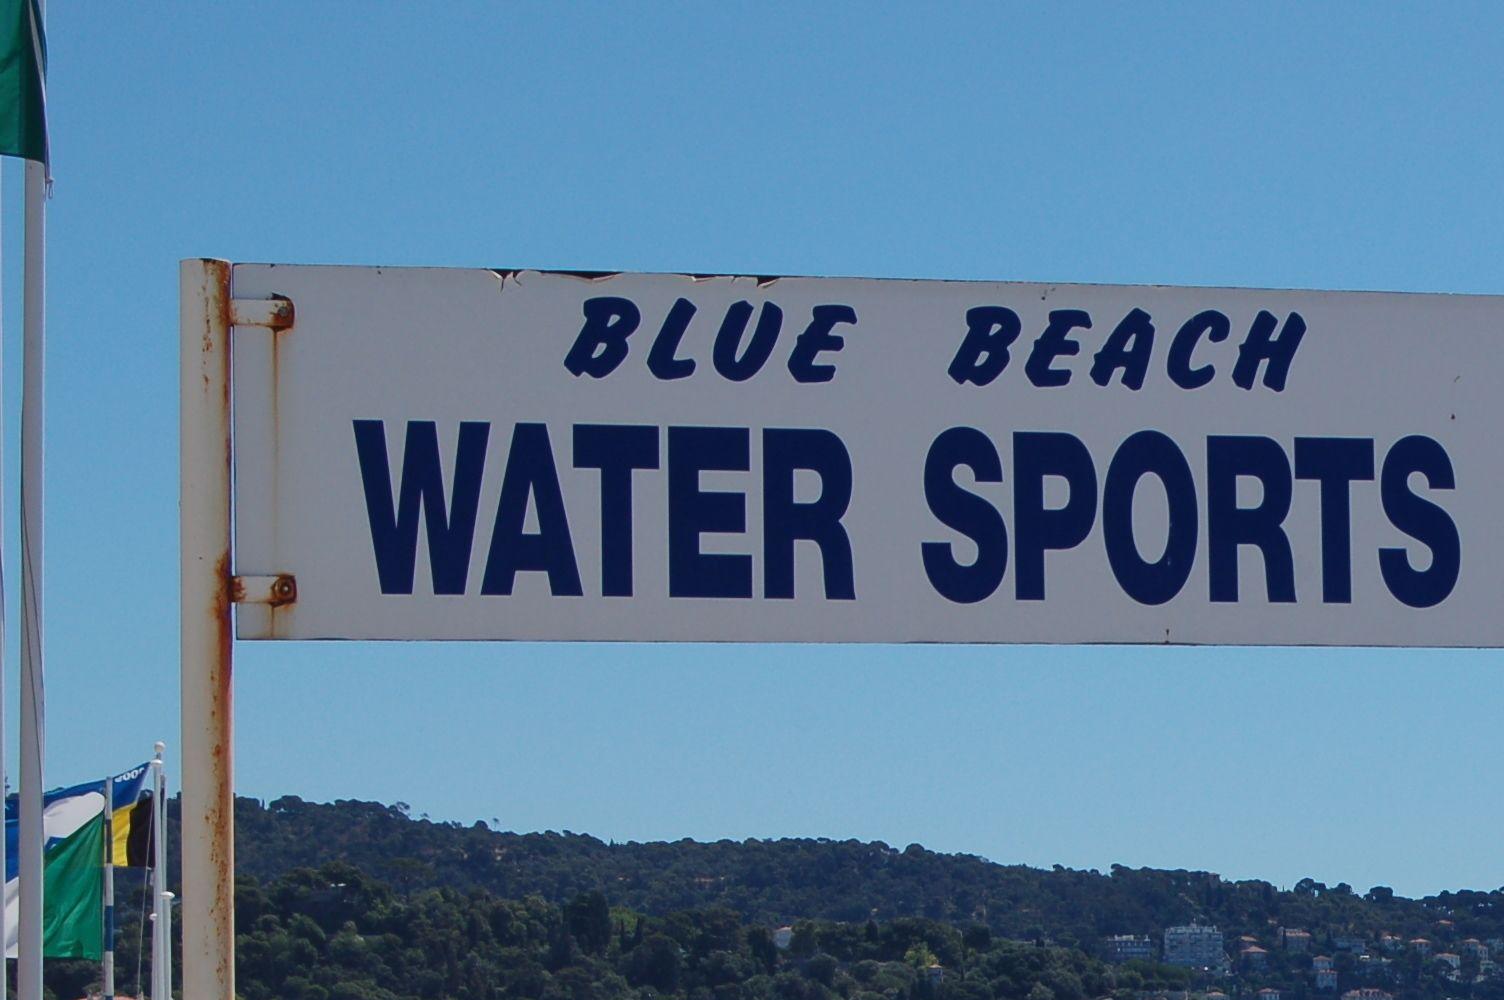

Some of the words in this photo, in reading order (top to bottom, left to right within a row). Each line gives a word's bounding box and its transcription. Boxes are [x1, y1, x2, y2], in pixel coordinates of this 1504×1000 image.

[562, 295, 859, 385] BLUE
[946, 304, 1308, 394] BEACH
[351, 418, 857, 602] WATER
[920, 425, 1462, 610] SPORTS
